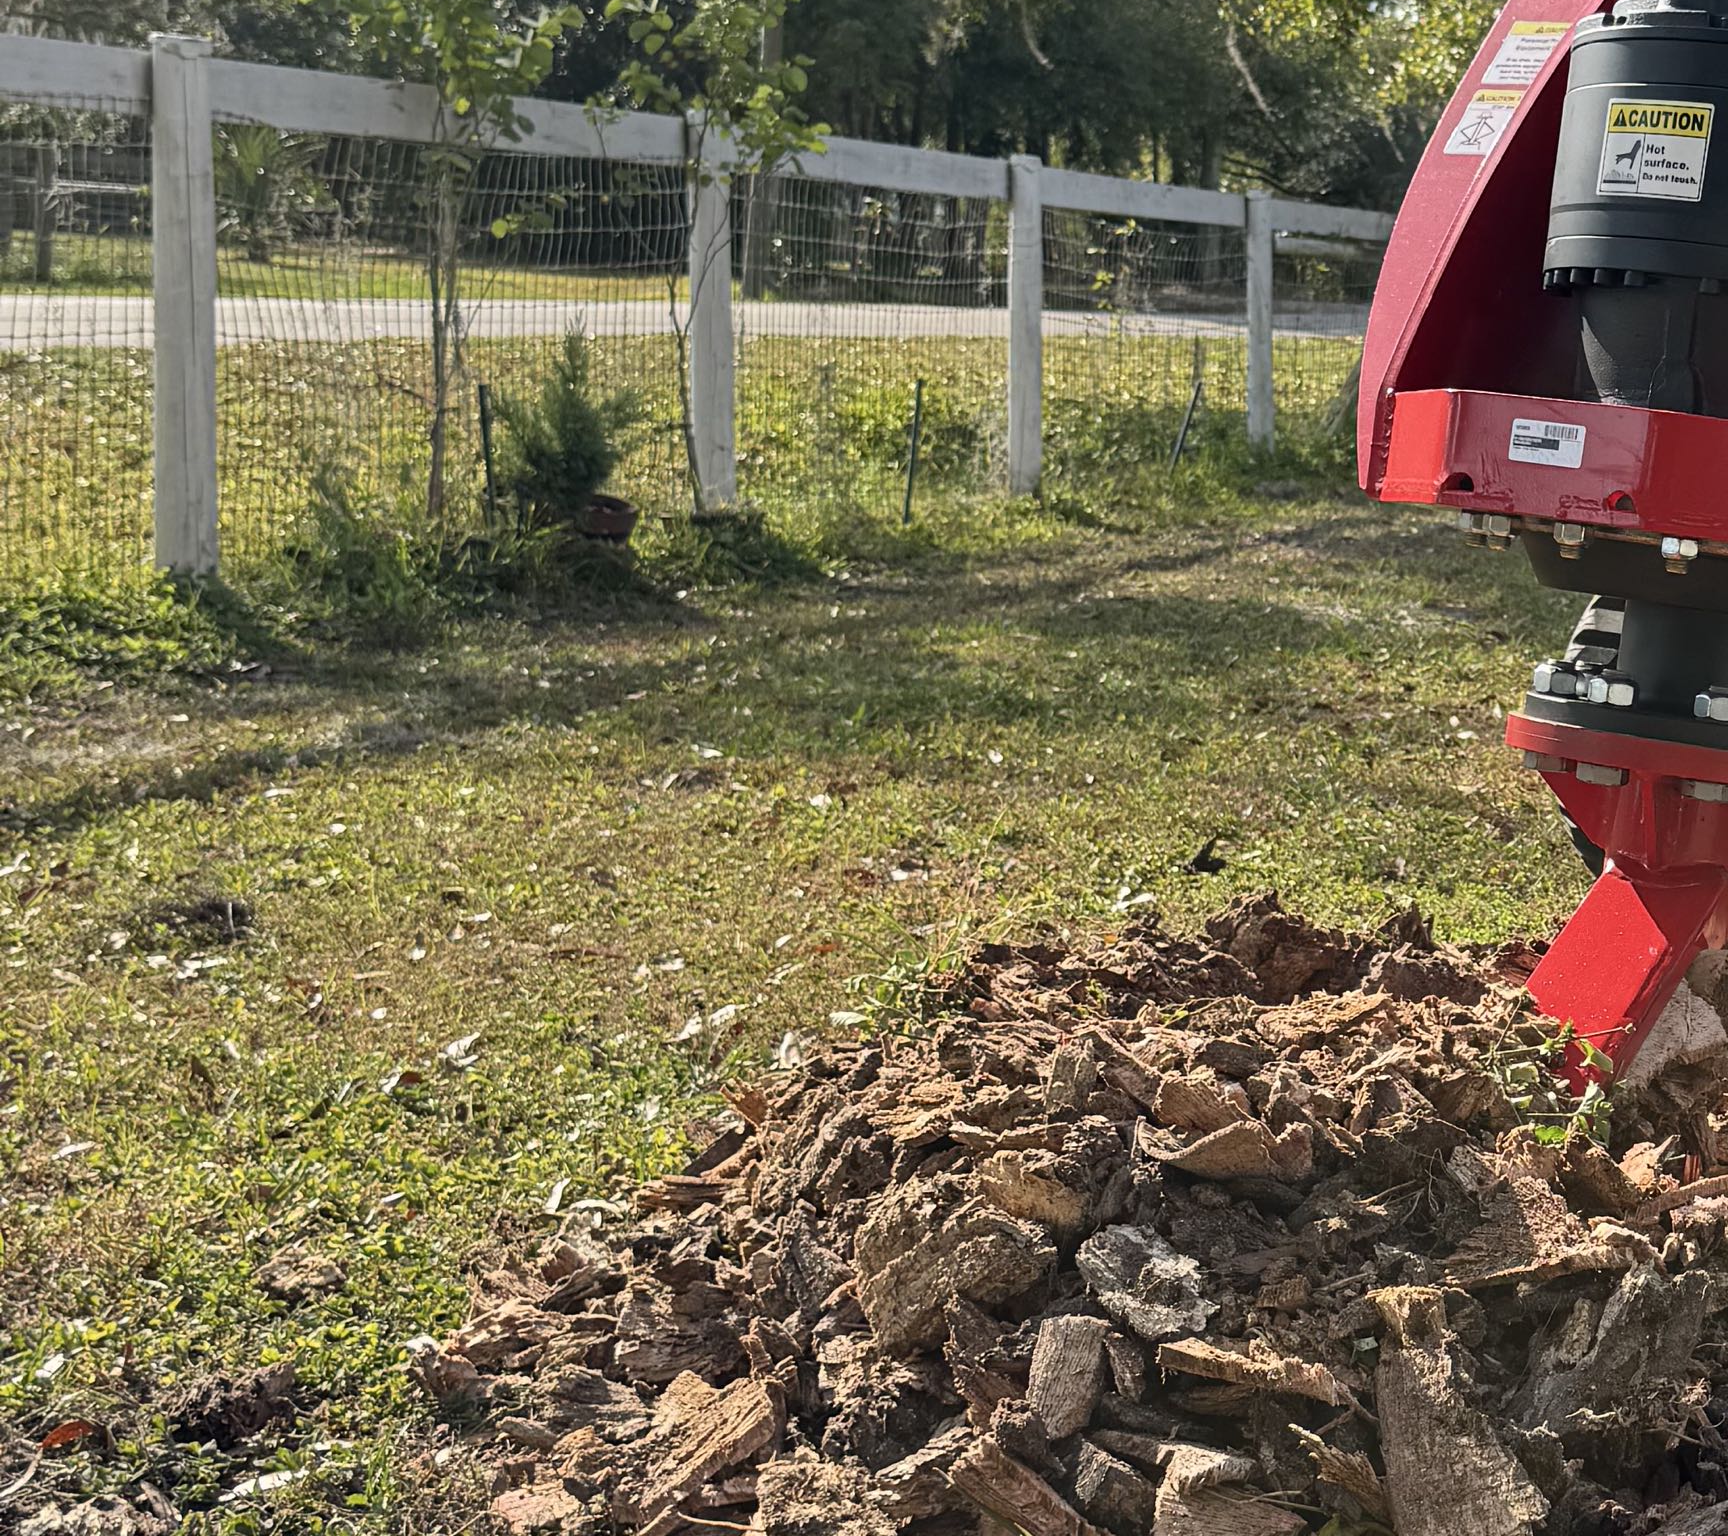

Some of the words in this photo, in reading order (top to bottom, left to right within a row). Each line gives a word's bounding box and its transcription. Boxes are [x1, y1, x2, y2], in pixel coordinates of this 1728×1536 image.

[1629, 110, 1704, 132] CAUTION
[1646, 144, 1665, 155] Hot
[1644, 158, 1690, 171] surface.
[1642, 172, 1652, 181] Do
[1655, 174, 1668, 182] not
